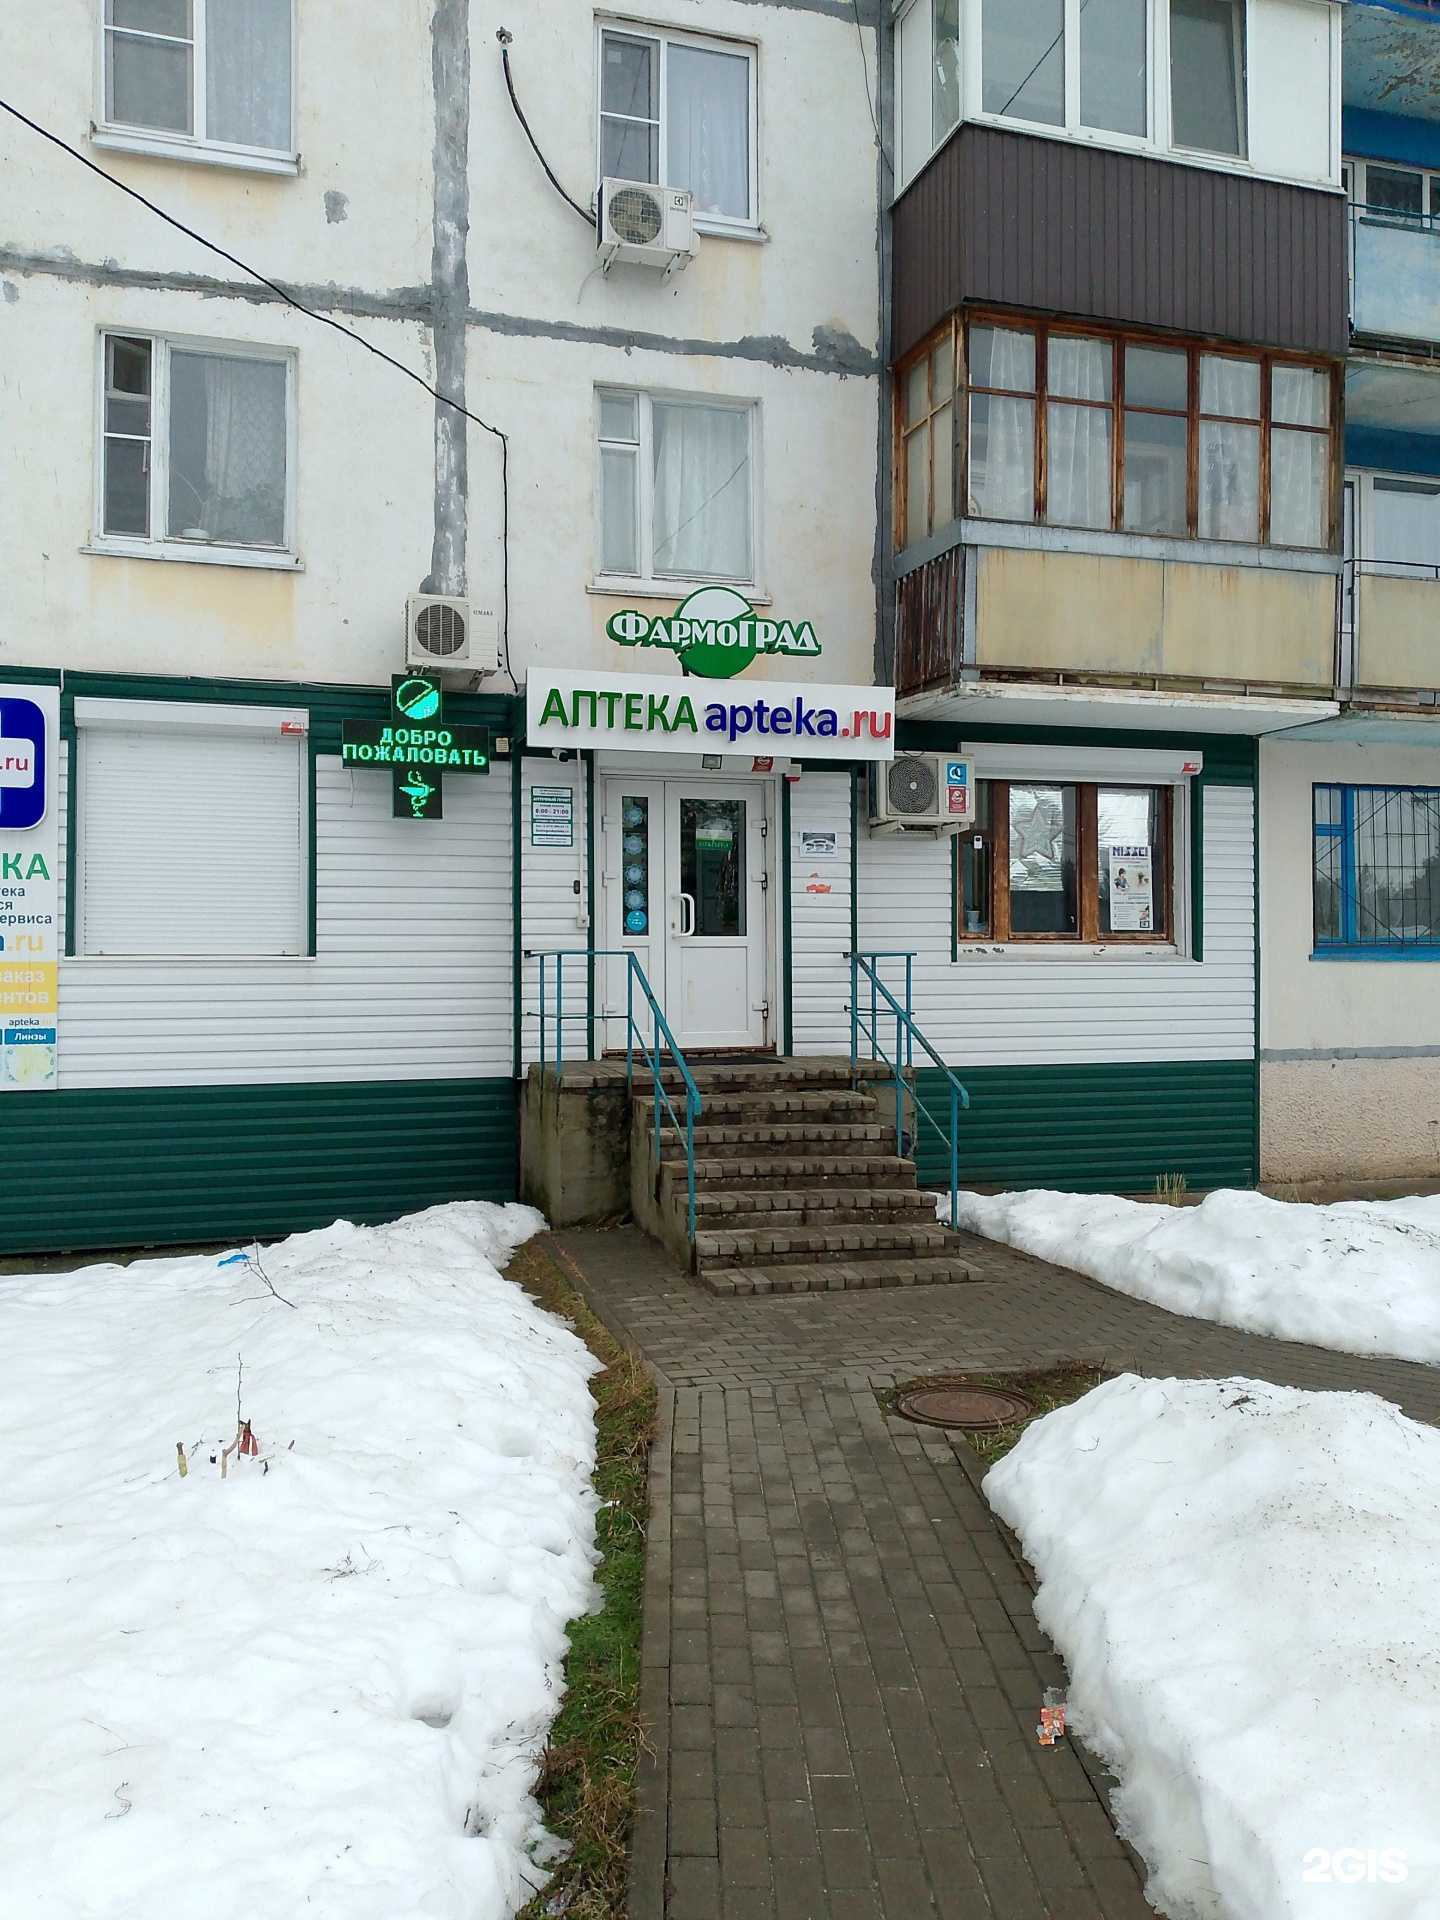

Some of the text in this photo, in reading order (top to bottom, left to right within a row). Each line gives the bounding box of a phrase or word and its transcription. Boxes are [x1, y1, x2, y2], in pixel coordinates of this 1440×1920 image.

[610, 610, 821, 653] ФАРМОГРАД
[539, 688, 891, 743] АПТЕКА apteka.ru
[380, 728, 452, 746] ДОБРО
[342, 744, 486, 766] ПОЖАЛОВАТЬ
[1112, 846, 1148, 857] NISSEI
[3, 853, 50, 880] КА
[0, 887, 25, 897] ека
[0, 914, 52, 927] ервиса
[0, 969, 45, 984] аказ
[0, 991, 49, 1004] нтов
[14, 1032, 47, 1041] Линзы
